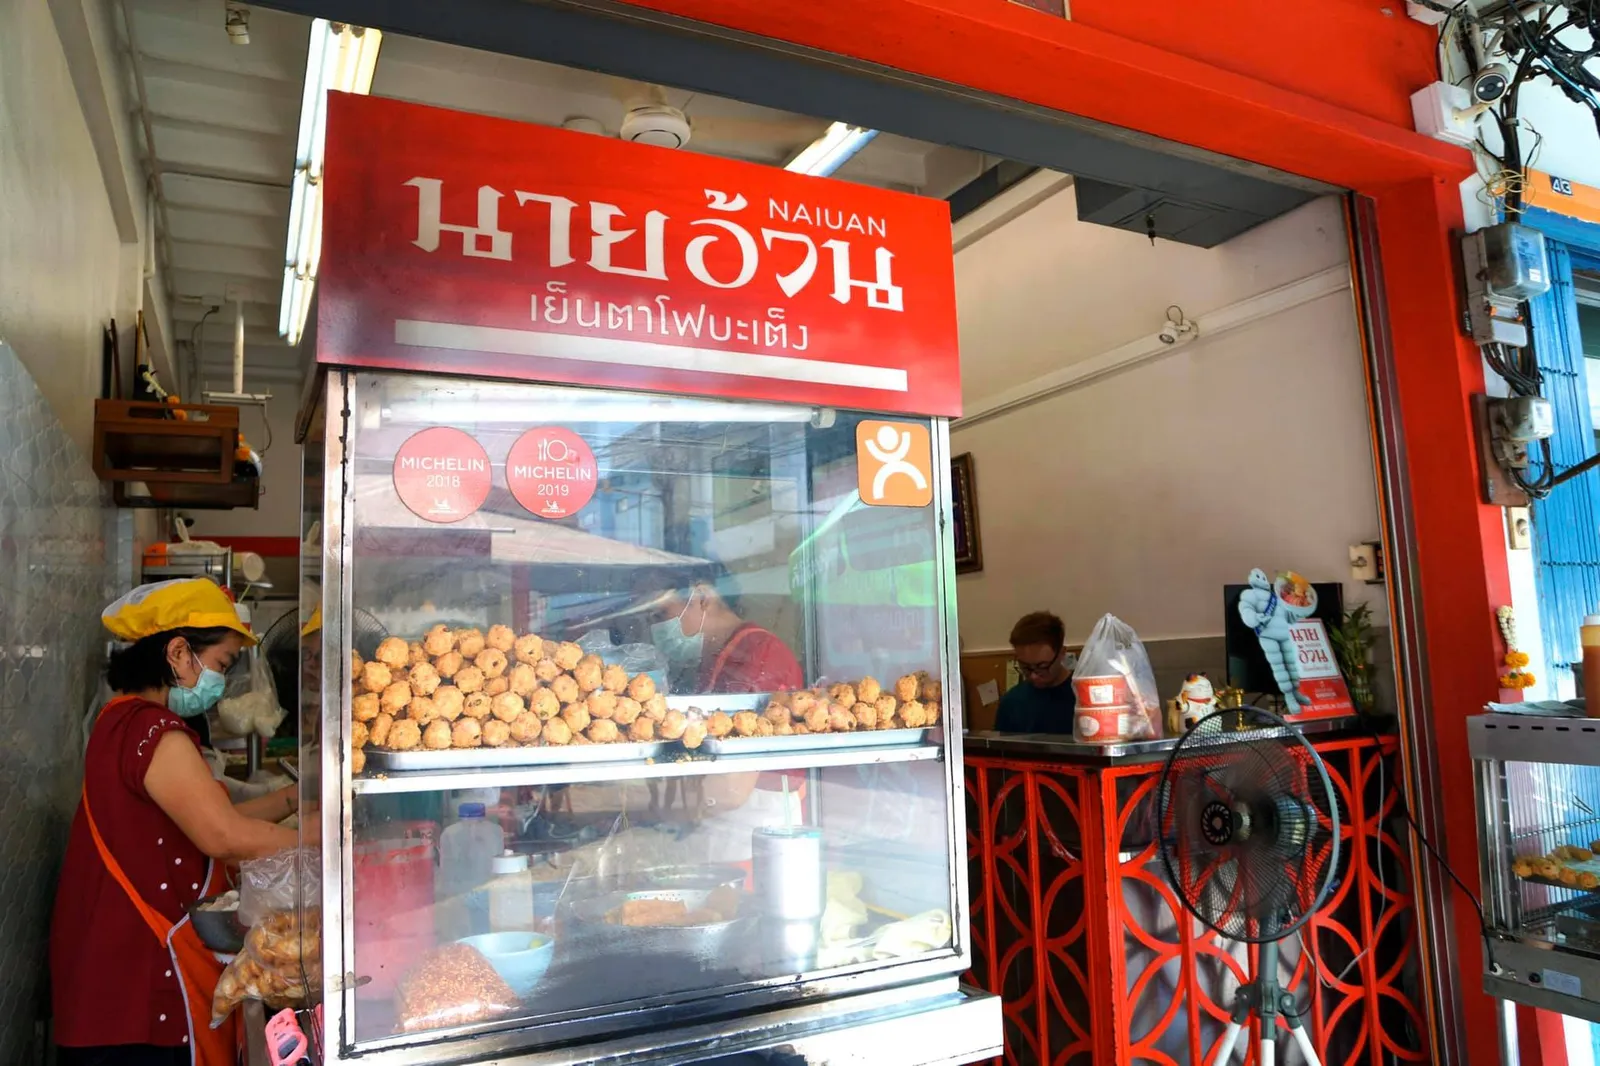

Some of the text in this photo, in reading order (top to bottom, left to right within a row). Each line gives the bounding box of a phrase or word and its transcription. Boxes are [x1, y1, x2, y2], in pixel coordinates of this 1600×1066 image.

[1553, 178, 1572, 195] 43
[769, 197, 886, 238] NAIUAN
[530, 280, 808, 350] เย็นตาโฟบะเต็ง
[401, 456, 485, 472] MICHELIN
[426, 474, 461, 488] 2018
[514, 466, 592, 480] MICHELIN
[537, 483, 569, 496] 2019
